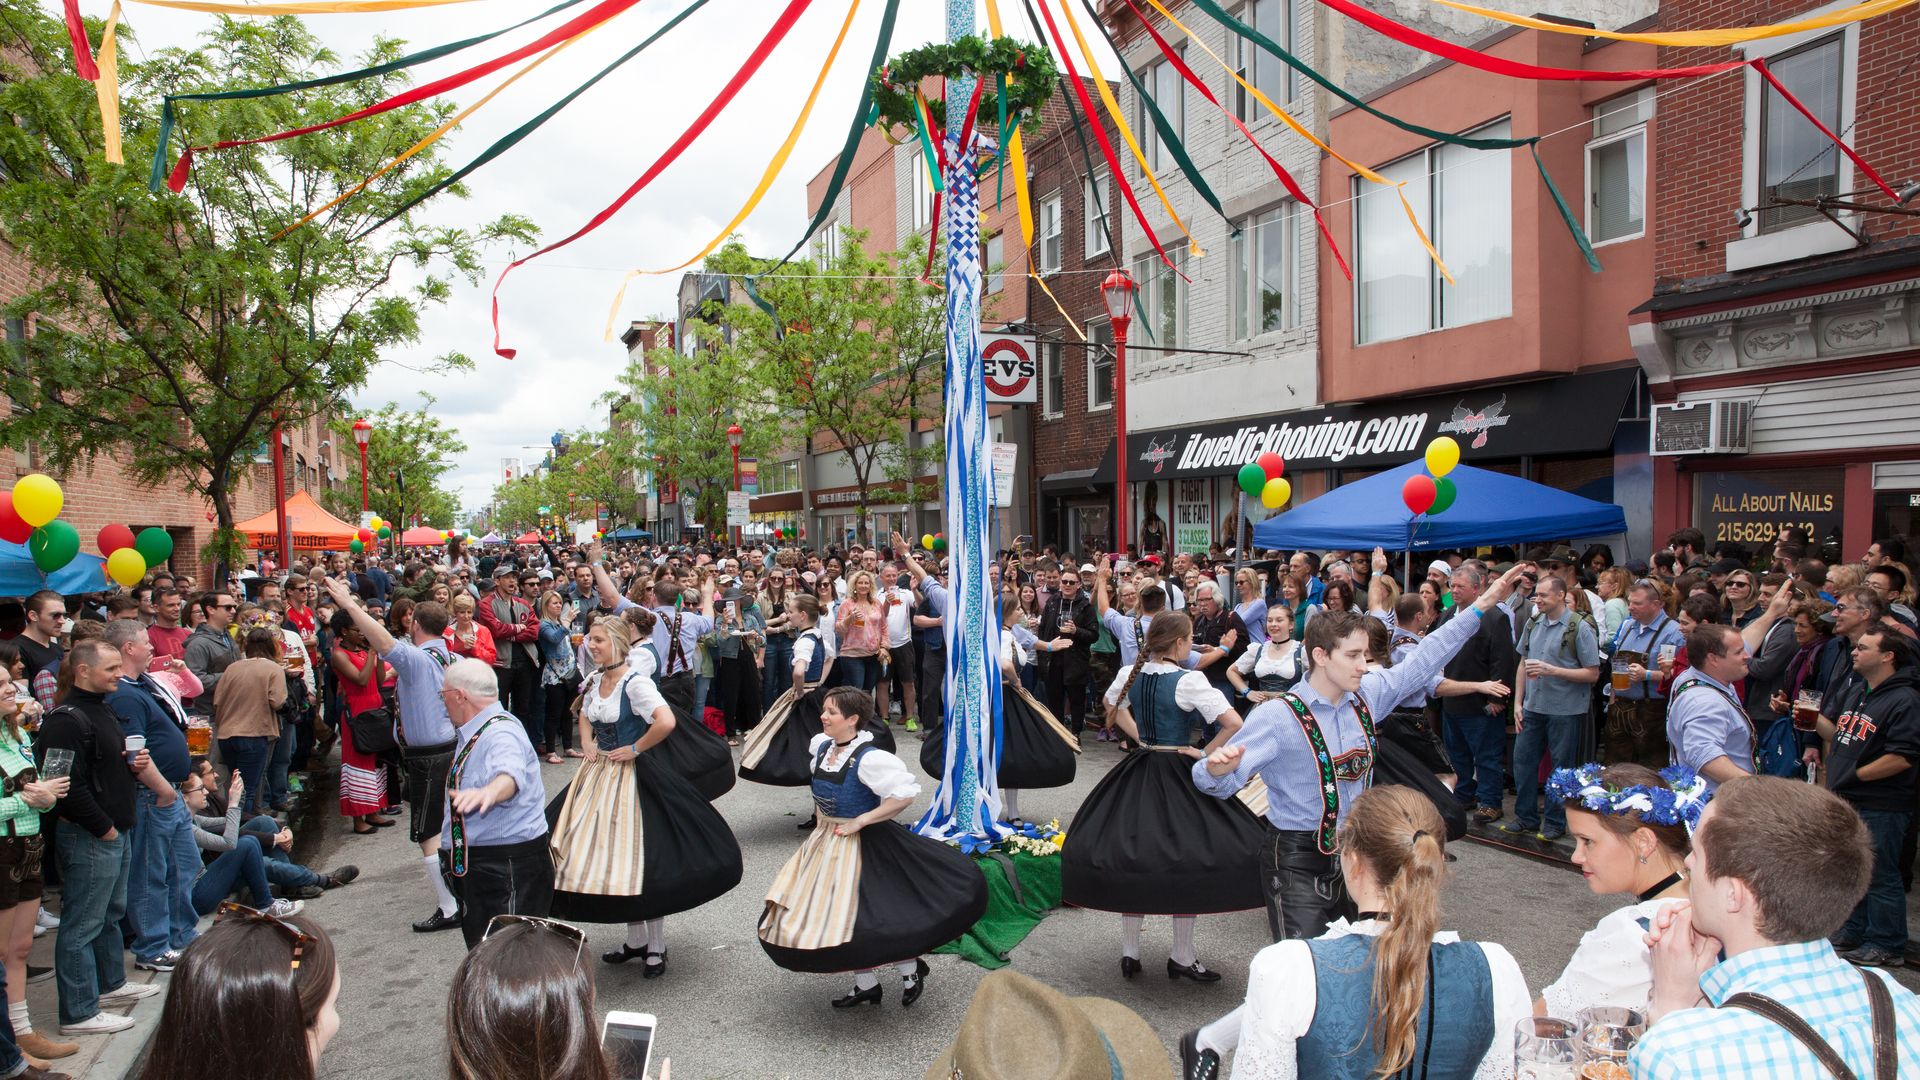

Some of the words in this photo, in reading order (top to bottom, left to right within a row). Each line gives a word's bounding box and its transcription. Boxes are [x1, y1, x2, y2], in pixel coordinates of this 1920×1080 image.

[982, 360, 1035, 378] EVS
[1177, 412, 1429, 470] iLoveKickboxing.com
[1181, 479, 1205, 502] FIGHT
[1178, 504, 1191, 524] THE
[1193, 503, 1209, 524] FAT!
[1184, 529, 1208, 545] CLASSES
[1837, 714, 1877, 741] RIT
